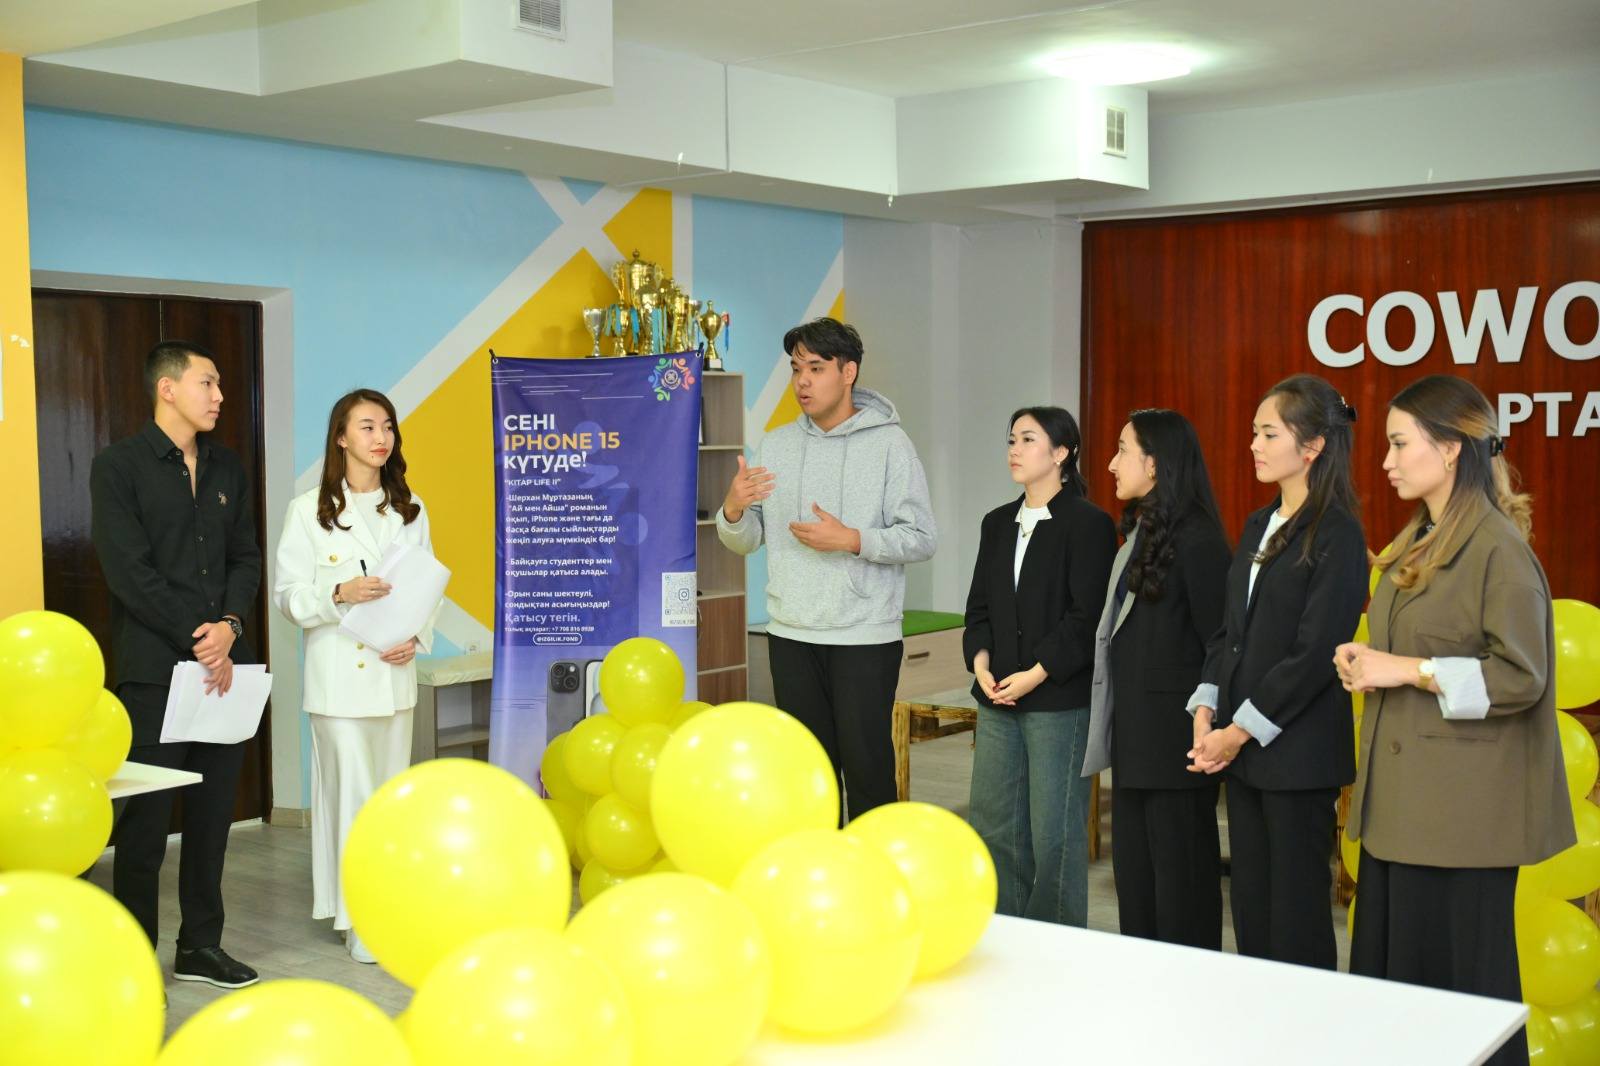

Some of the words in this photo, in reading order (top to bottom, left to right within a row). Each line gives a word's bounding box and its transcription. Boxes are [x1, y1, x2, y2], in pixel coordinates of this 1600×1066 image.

[1307, 281, 1600, 368] COWO
[503, 413, 555, 431] СЕНІ
[503, 433, 593, 451] IPHONE
[598, 432, 621, 449] 15
[503, 451, 587, 474] күтуде!
[533, 478, 551, 486] LIFE
[570, 504, 608, 513] романын
[531, 514, 558, 522] iPhone
[602, 514, 613, 523] да
[598, 535, 616, 545] бар!
[549, 557, 595, 566] студенттер
[596, 557, 613, 565] мен
[580, 568, 609, 576] алады.
[554, 588, 594, 598] шектеулі,
[505, 601, 550, 609] сондықтан
[504, 612, 548, 624] Қатысу
[549, 612, 581, 622] тегін.
